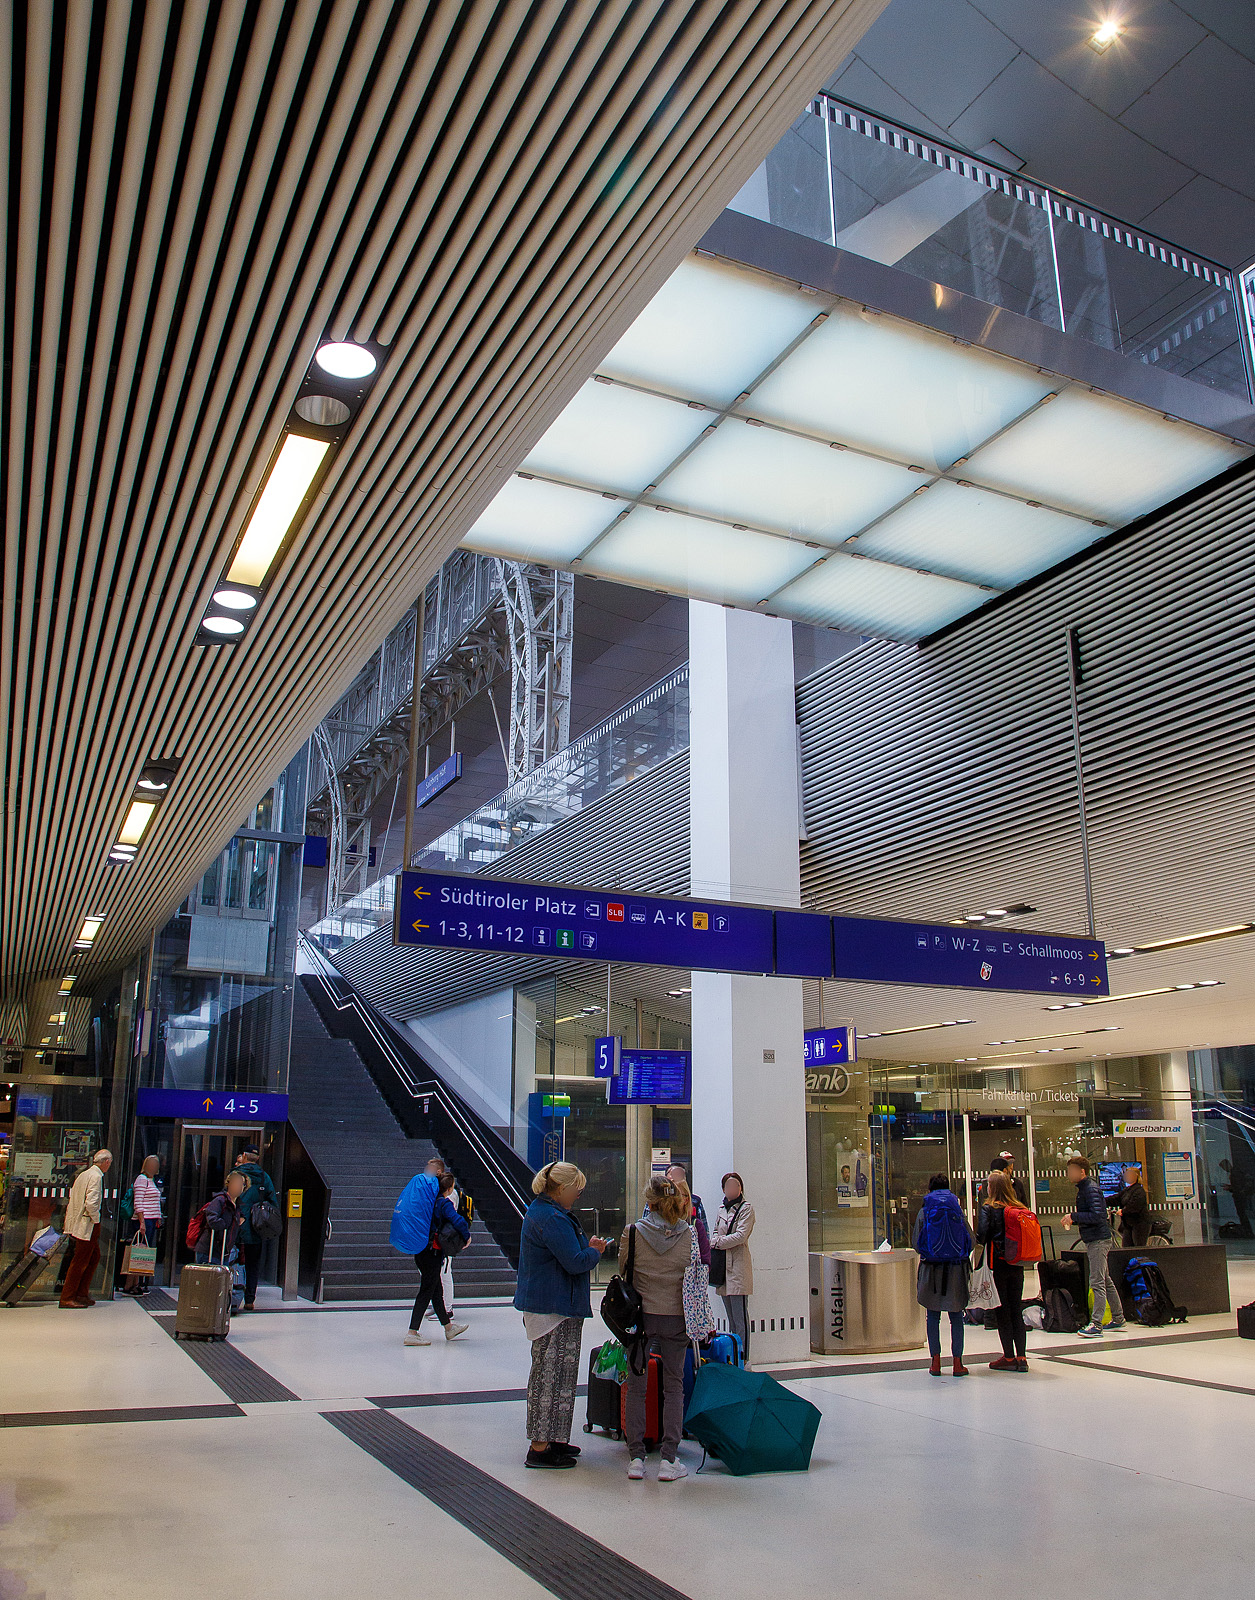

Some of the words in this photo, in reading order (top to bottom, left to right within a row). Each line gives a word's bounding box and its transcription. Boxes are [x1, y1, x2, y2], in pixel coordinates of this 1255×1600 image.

[440, 887, 529, 911] Südtiroler
[535, 897, 577, 916] Platz
[608, 908, 623, 917] SLB
[951, 937, 980, 952] W-Z
[1018, 942, 1084, 960] Schallmoos
[599, 1044, 608, 1070] 5
[805, 1068, 843, 1090] ank
[982, 1087, 1037, 1101] Fahrkarten
[1044, 1089, 1079, 1102] Tickets
[1125, 1125, 1181, 1133] westbahn.at
[830, 1288, 844, 1340] Abfall
